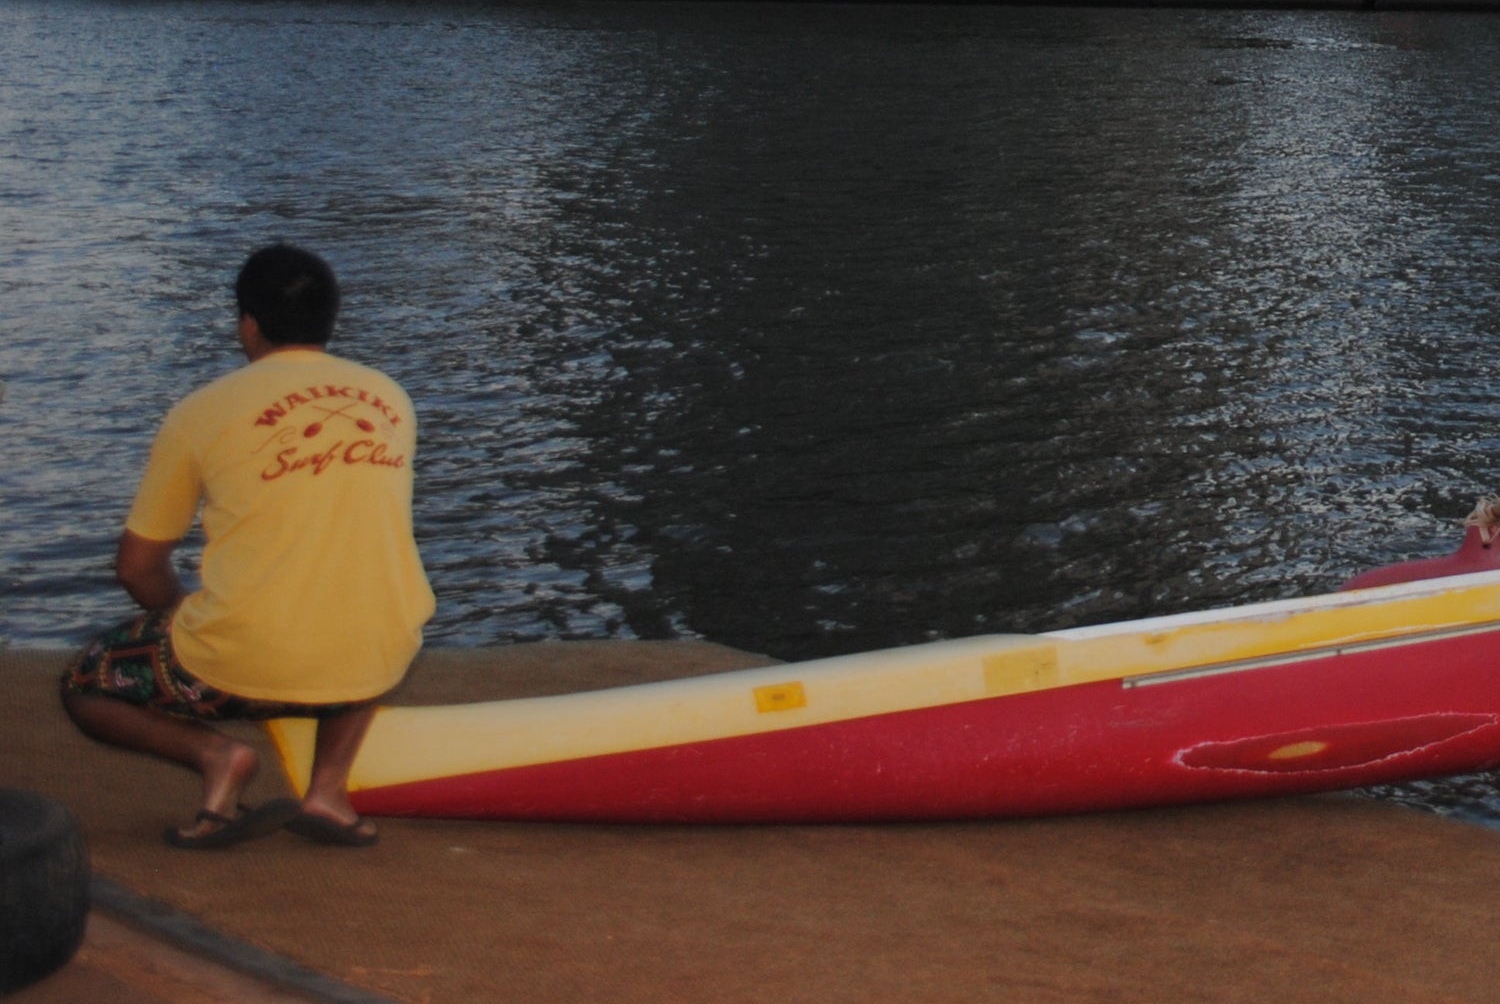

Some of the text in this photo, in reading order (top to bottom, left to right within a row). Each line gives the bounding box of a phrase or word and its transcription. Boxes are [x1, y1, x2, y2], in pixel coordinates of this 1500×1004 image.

[254, 385, 402, 427] WAIKIKI
[261, 439, 405, 481] Surf Club
